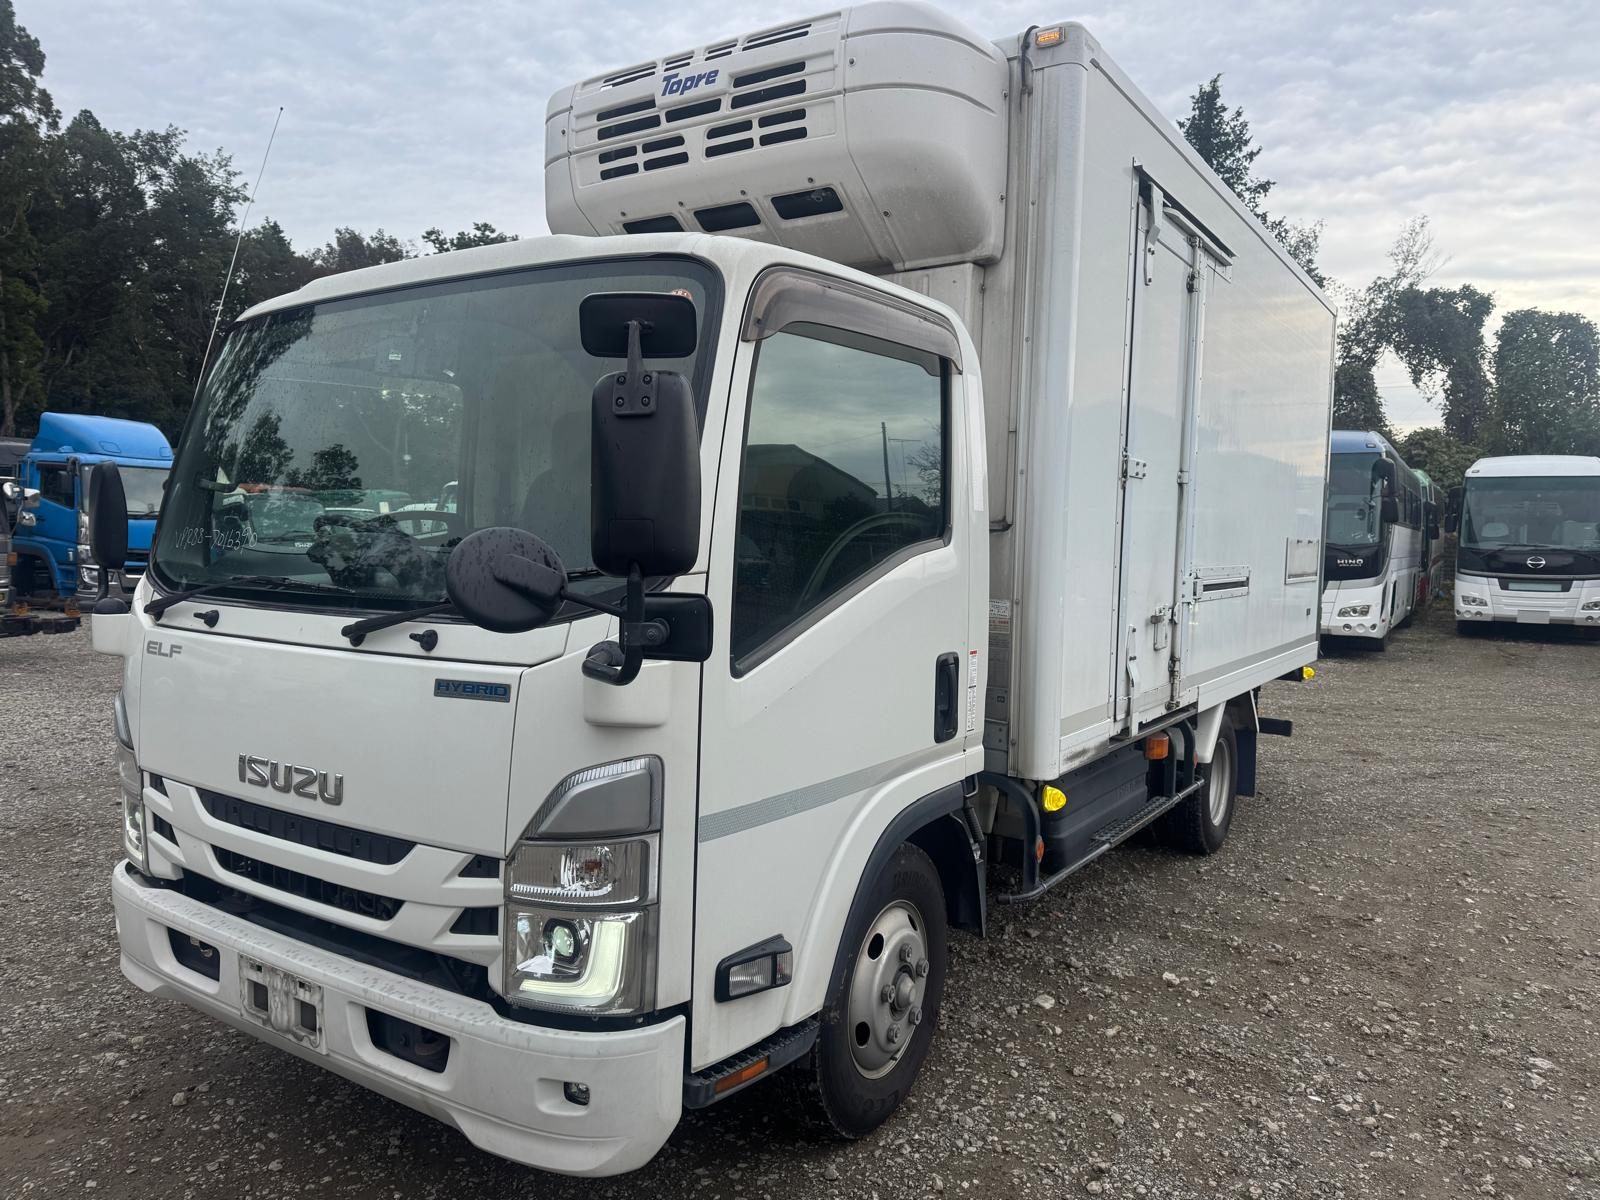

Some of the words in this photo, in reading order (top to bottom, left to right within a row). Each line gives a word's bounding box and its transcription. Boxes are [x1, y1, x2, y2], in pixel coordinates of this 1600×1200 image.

[661, 69, 719, 96] Topre
[146, 640, 183, 658] ELF
[437, 682, 508, 697] HYBRID
[238, 752, 344, 806] ISUZU
